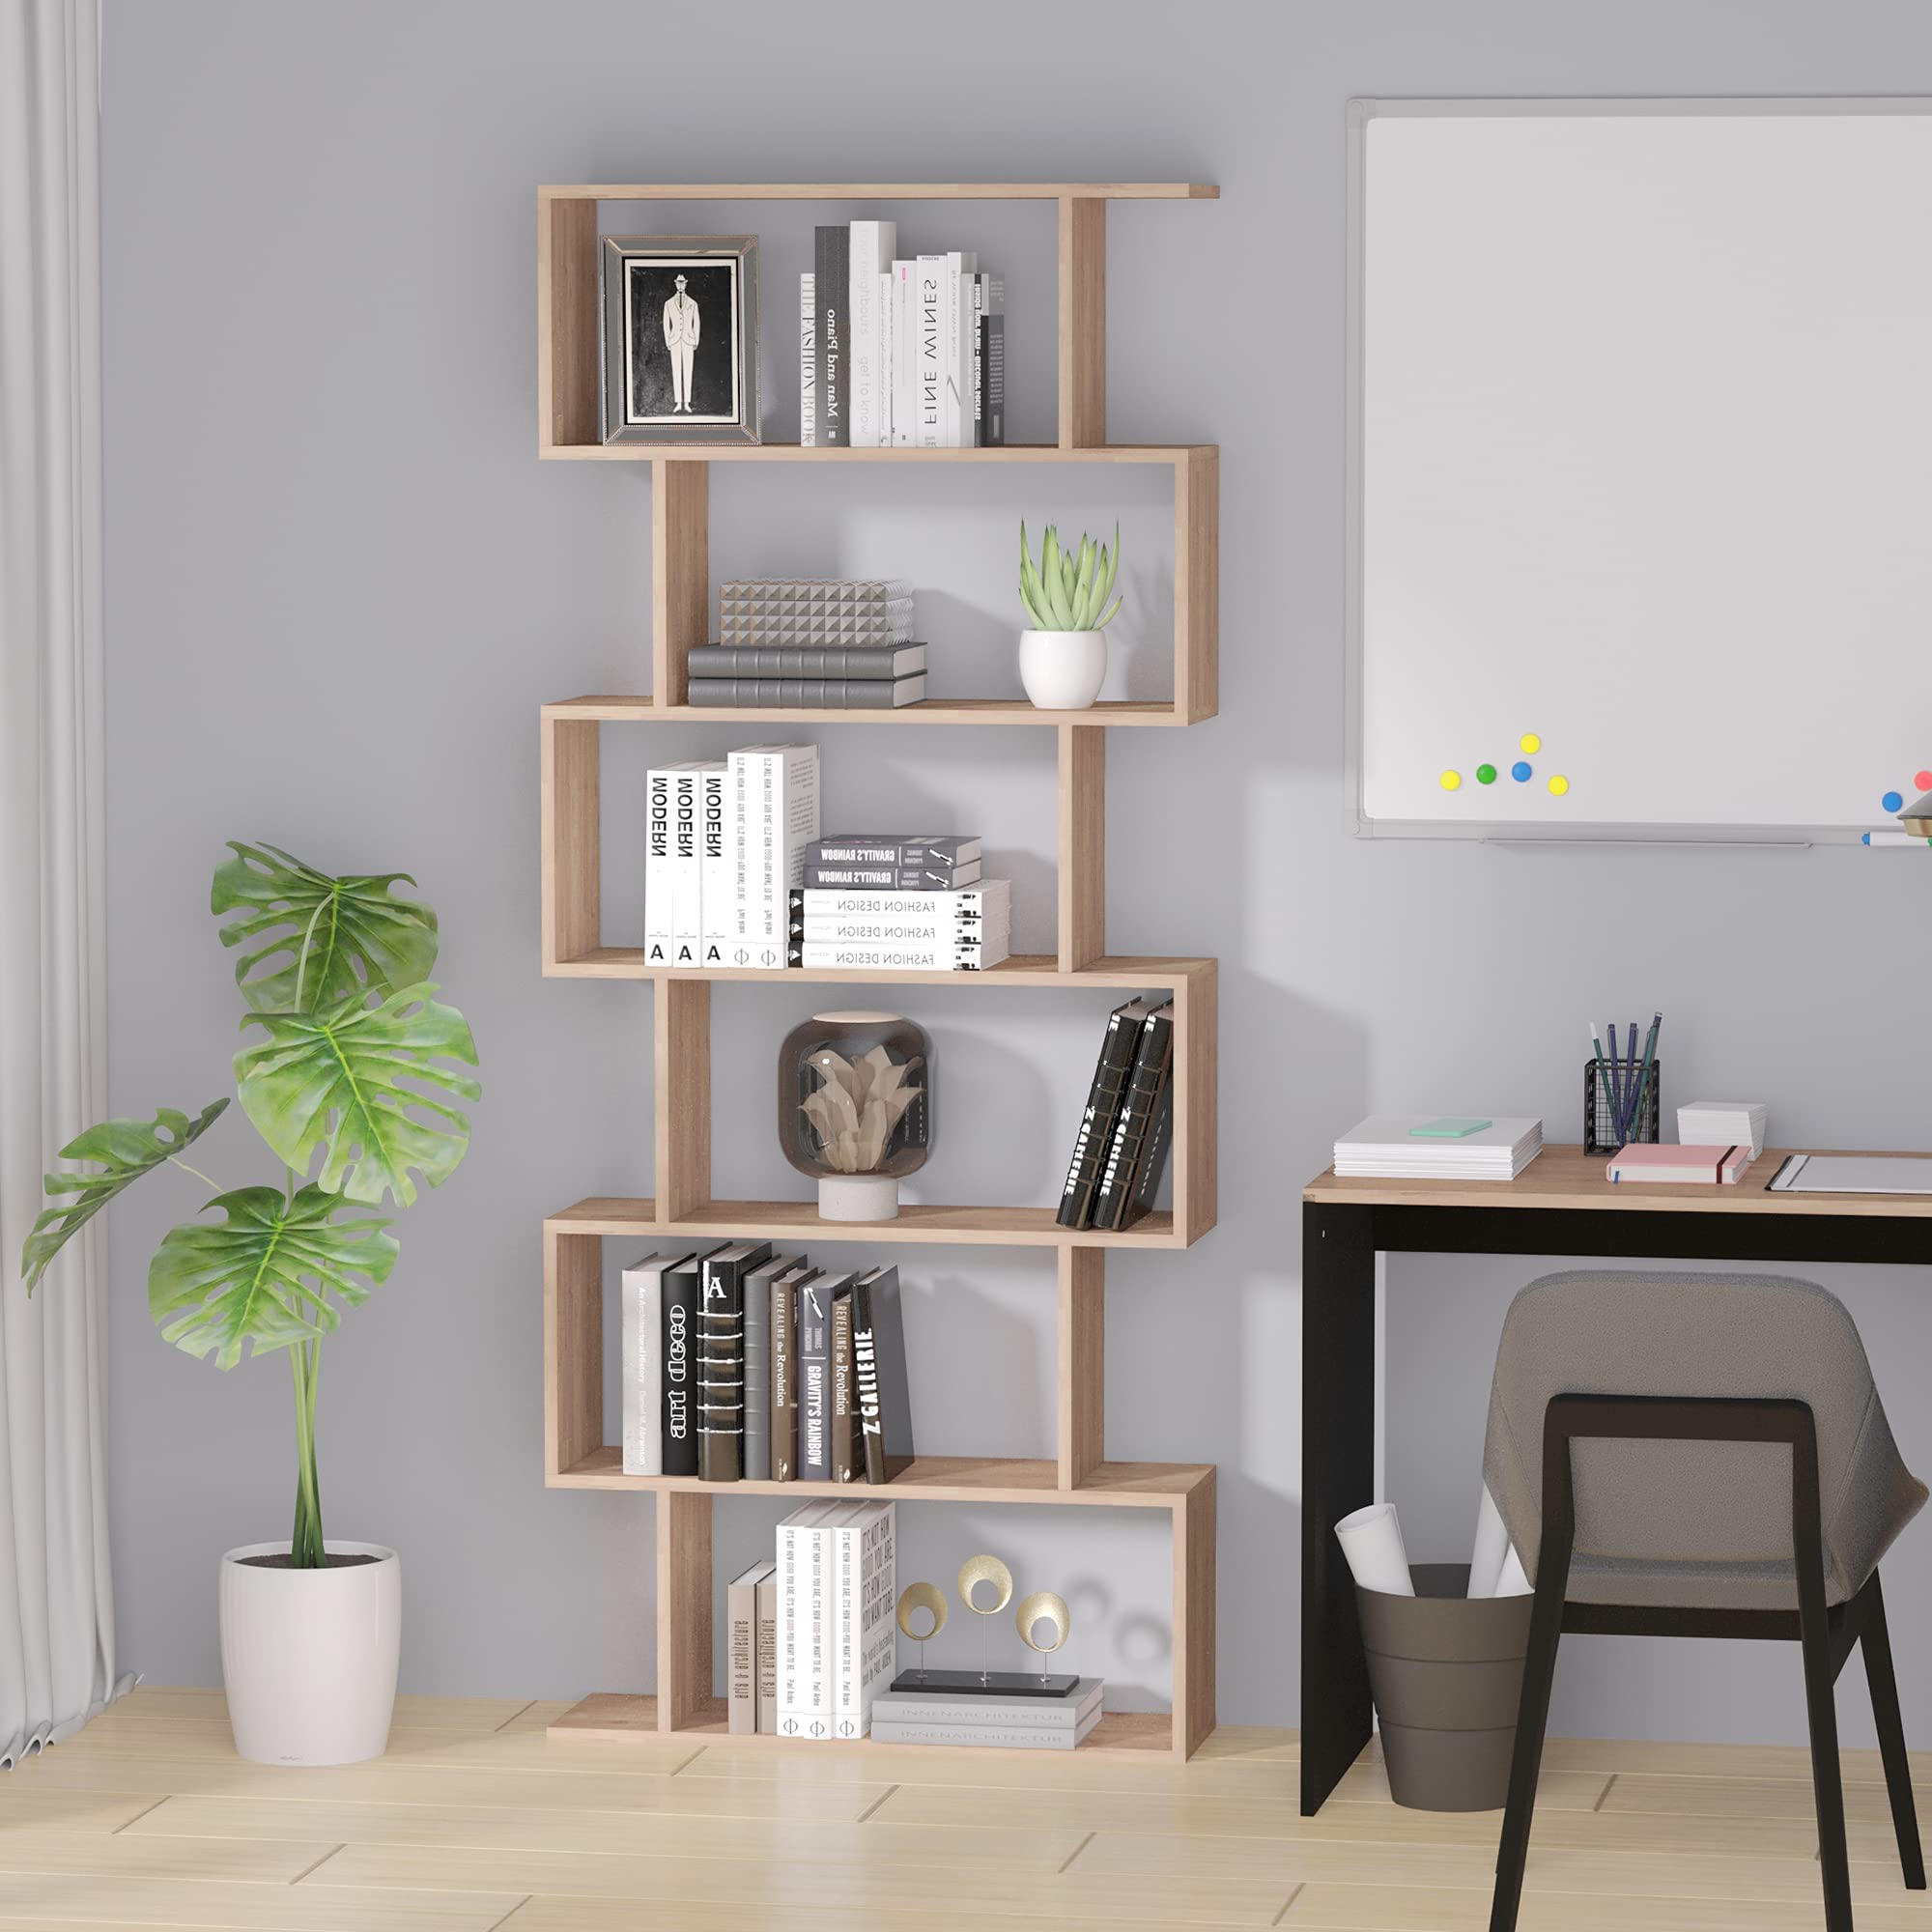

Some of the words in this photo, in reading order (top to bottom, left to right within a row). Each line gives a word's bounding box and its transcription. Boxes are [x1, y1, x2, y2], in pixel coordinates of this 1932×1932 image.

[802, 276, 815, 303] THE
[857, 262, 872, 335] neighbours
[802, 316, 815, 389] FASHION
[857, 355, 872, 377] get
[860, 383, 871, 396] to
[860, 399, 871, 435] know
[650, 945, 664, 959] A
[678, 945, 693, 960] A
[707, 945, 721, 960] A
[1085, 1106, 1096, 1121] Z
[1121, 1106, 1132, 1122] Z
[639, 1287, 646, 1299] An
[708, 1277, 727, 1298] A
[777, 1293, 785, 1339] REVEALING
[837, 1305, 846, 1350] REVEALING
[668, 1305, 687, 1381] deco
[637, 1354, 646, 1383] History
[836, 1353, 845, 1363] the
[777, 1355, 786, 1406] Revolution
[807, 1365, 822, 1417] GRAVITY'S
[836, 1365, 846, 1415] Revolution
[668, 1390, 687, 1438] art
[863, 1421, 880, 1435] Z
[808, 1419, 822, 1465] RAINBOW
[731, 1620, 749, 1670] architecture
[759, 1619, 775, 1668] architecture
[732, 1683, 749, 1699] arts
[760, 1682, 775, 1698] arts
[901, 1708, 1064, 1722] INNENARCHITEKTUR
[900, 1729, 1064, 1744] INNENARCHITEKTUR
